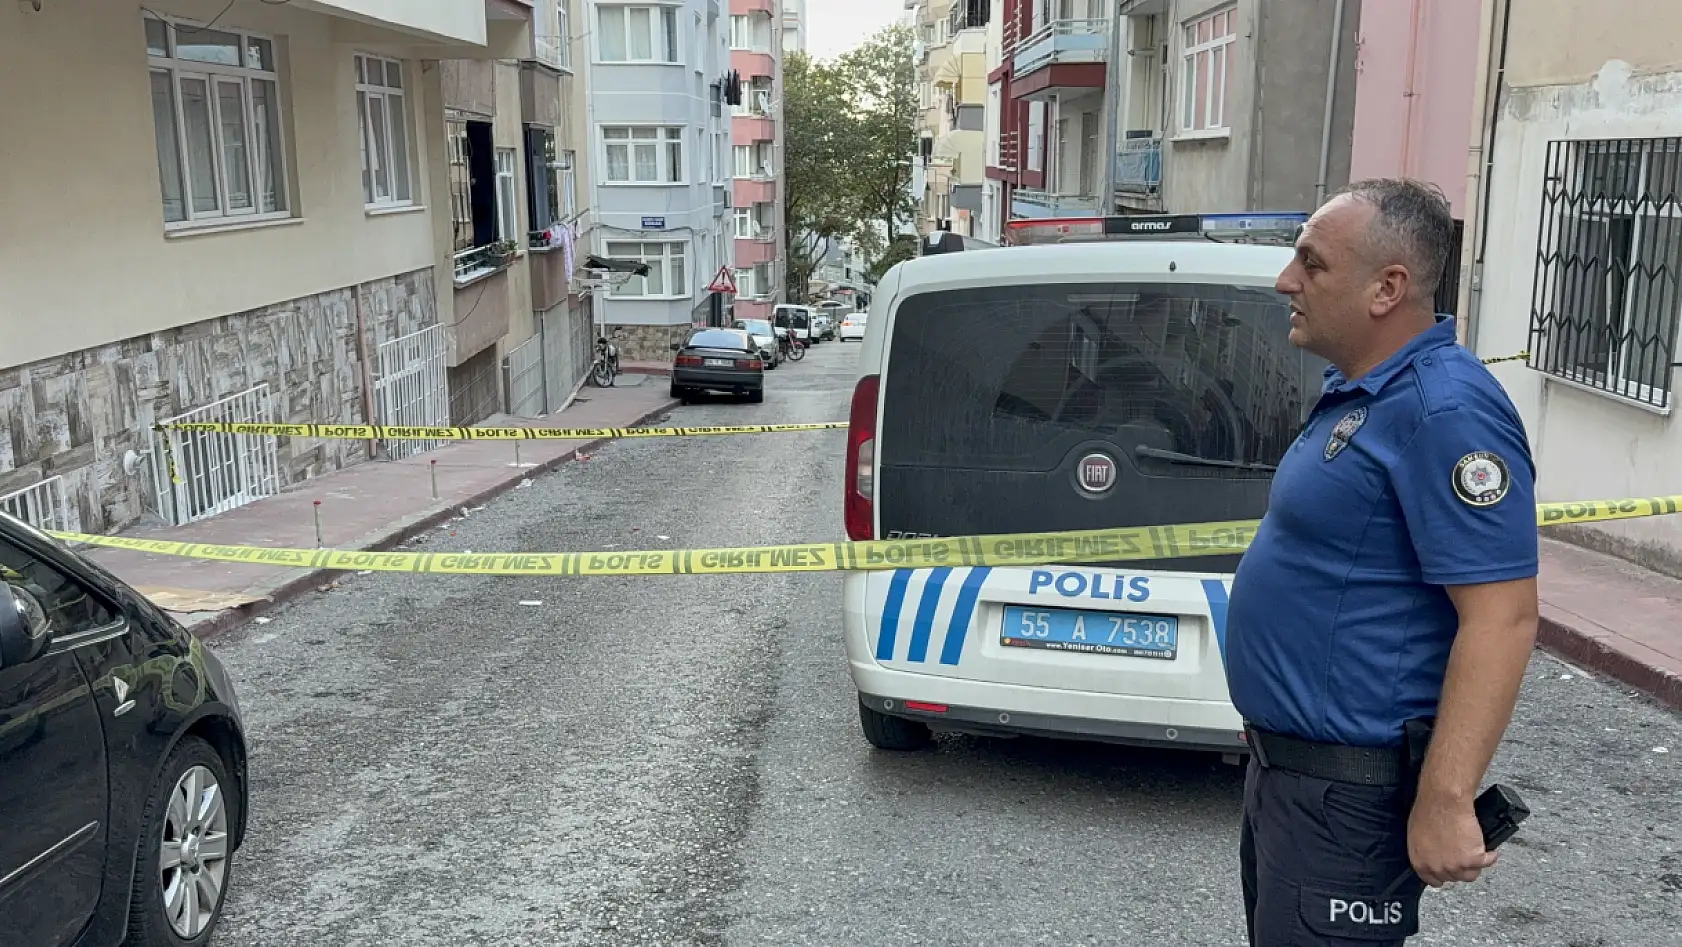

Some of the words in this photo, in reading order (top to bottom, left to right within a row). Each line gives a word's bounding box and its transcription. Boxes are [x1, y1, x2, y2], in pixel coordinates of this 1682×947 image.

[1131, 221, 1172, 230] armas
[1086, 464, 1109, 483] FIAT
[1021, 612, 1050, 637] 55
[1072, 615, 1087, 640] A
[1107, 616, 1171, 647] 7538
